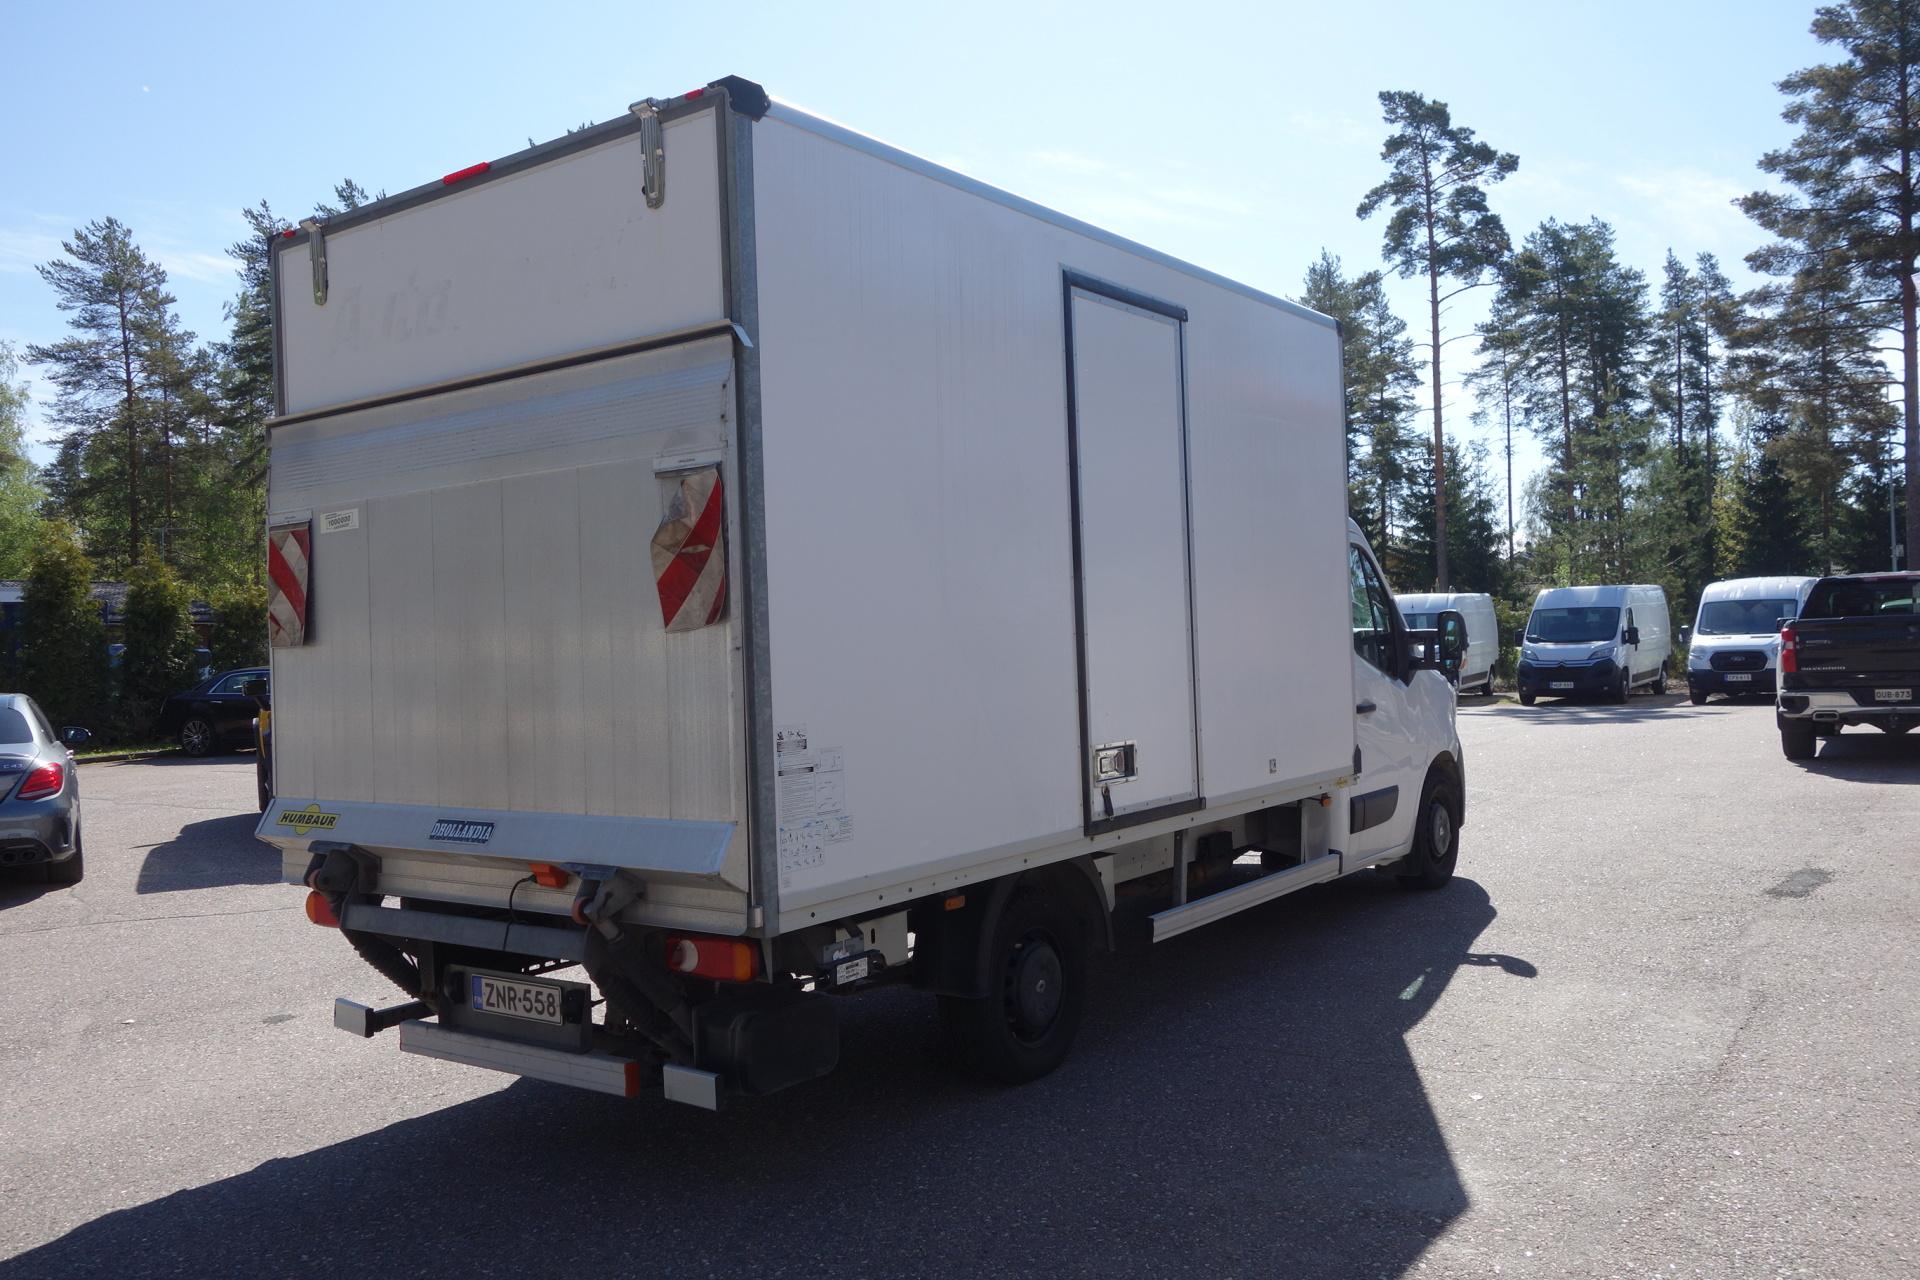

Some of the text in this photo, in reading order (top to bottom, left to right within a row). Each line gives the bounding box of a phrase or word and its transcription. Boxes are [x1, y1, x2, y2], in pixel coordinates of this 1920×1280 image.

[280, 813, 336, 826] HUMBAUR
[431, 822, 492, 840] DHOLLANDIA
[484, 982, 557, 1018] ZNR-558
